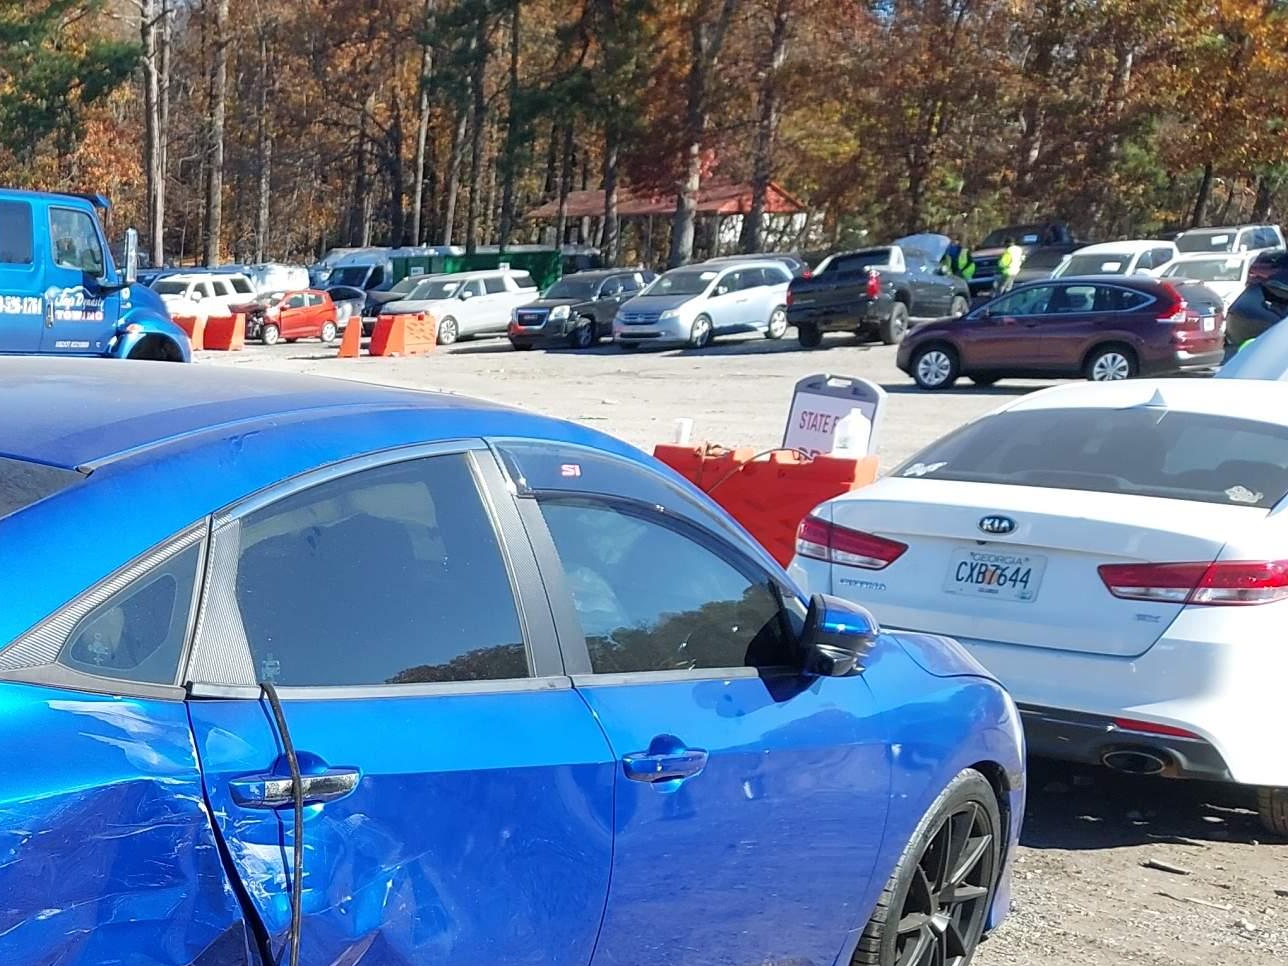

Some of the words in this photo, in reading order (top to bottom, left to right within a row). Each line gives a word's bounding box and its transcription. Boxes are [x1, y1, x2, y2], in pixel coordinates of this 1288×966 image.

[54, 310, 105, 321] TOWING
[799, 410, 831, 433] STATE
[982, 518, 1010, 532] KIA
[972, 553, 1023, 565] GEORGIA
[955, 561, 1032, 590] CXB7644
